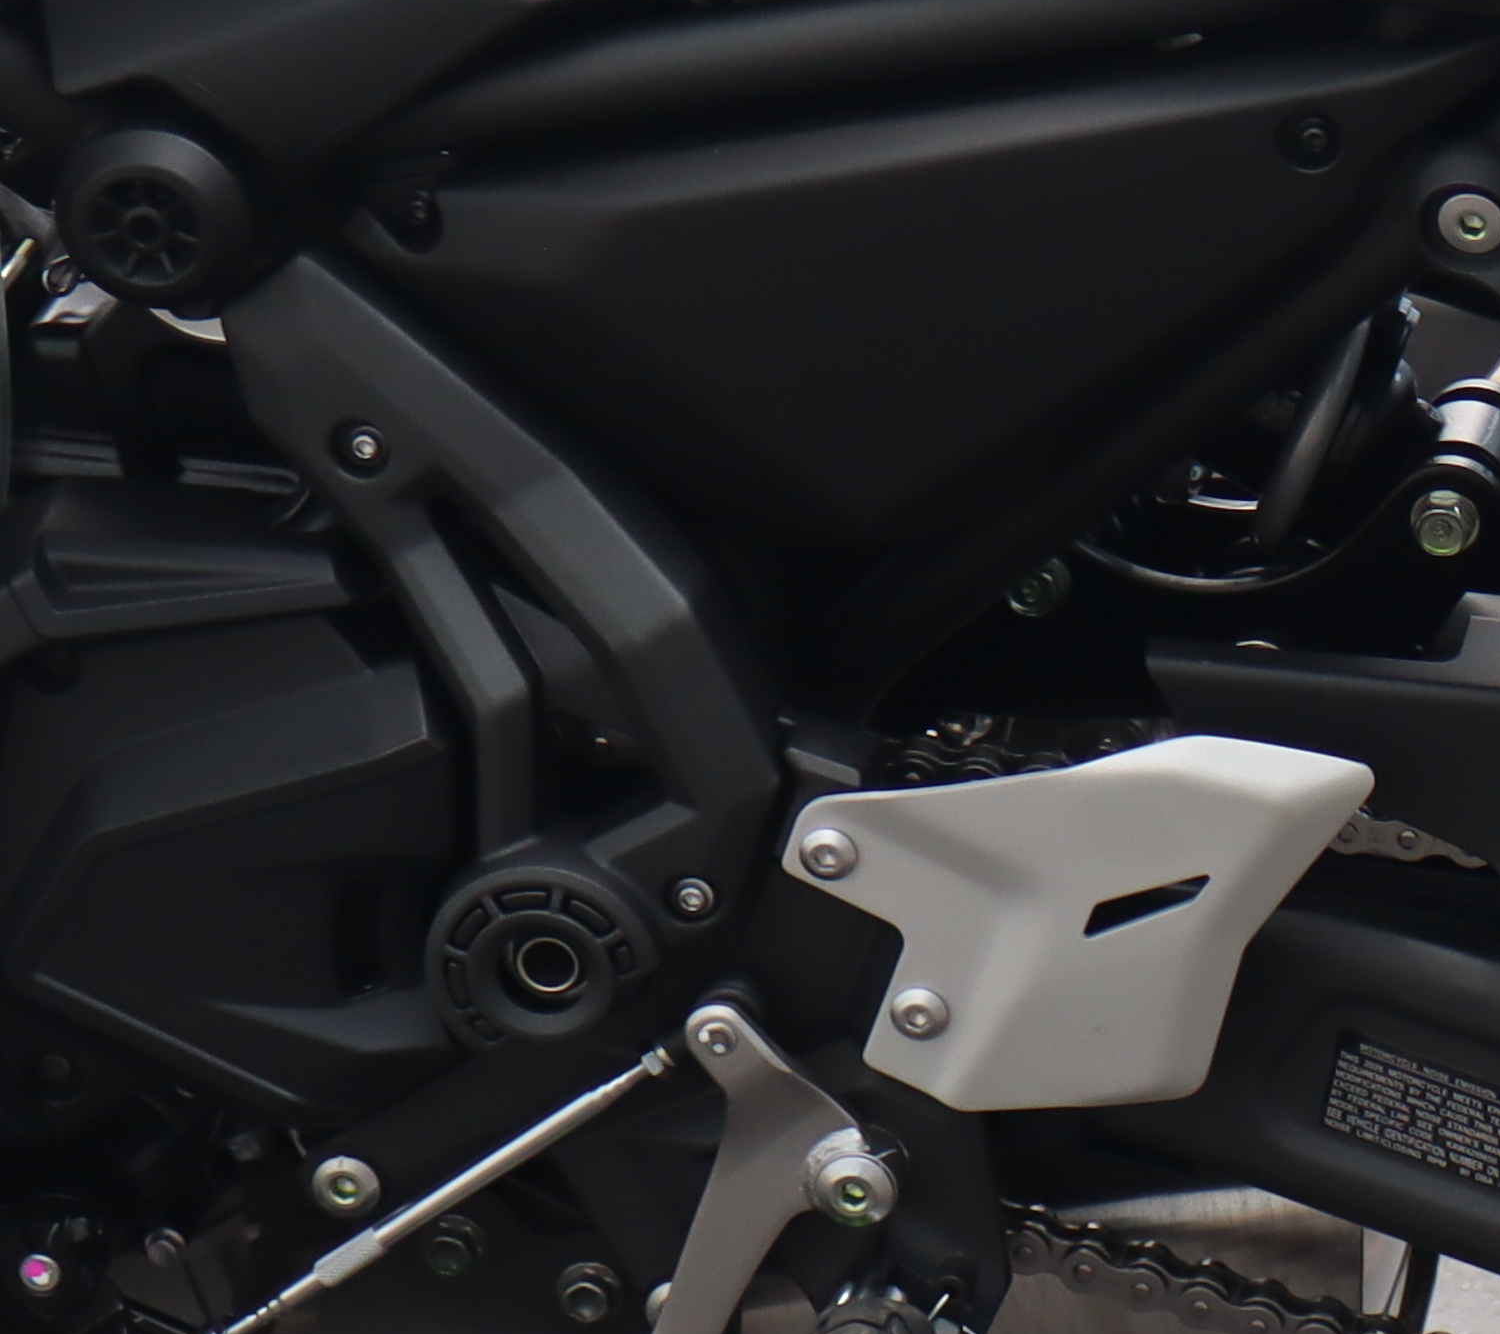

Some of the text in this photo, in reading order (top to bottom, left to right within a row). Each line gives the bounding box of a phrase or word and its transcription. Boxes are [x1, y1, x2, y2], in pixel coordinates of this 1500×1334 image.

[1337, 1059, 1404, 1090] REQUIREMENTS
[1425, 1092, 1440, 1103] THE
[1446, 1100, 1484, 1120] FEDERAL
[1340, 1050, 1358, 1063] THIS
[1387, 1068, 1447, 1096] MOTORCYCLE
[1452, 1092, 1482, 1108] MEETS
[1359, 1043, 1417, 1070] MOTORCYCLE
[1422, 1066, 1448, 1081] NOISE
[1454, 1078, 1496, 1099] EMISSION
[1328, 1097, 1358, 1114] MODEL
[1363, 1110, 1403, 1131] SPECIFIC
[1333, 1079, 1368, 1097] EXCEED
[1372, 1093, 1410, 1112] FEDERAL
[1414, 1108, 1441, 1124] NOISE
[1447, 1120, 1498, 1145] STANDARDS
[1335, 1069, 1401, 1098] MODIFICATIONS
[1406, 1095, 1435, 1111] WHICH
[1439, 1107, 1467, 1123] CAUSE
[1473, 1119, 1492, 1132] THIS
[1346, 1093, 1386, 1114] FEDERAL
[1415, 1119, 1432, 1131] SEE
[1323, 1116, 1350, 1132] NOISE
[1426, 1154, 1447, 1168] RPM
[1326, 1105, 1342, 1119] SEE
[1346, 1113, 1379, 1134] VEHICLE
[1383, 1127, 1446, 1157] IDENTIFICATION
[1449, 1151, 1482, 1171] NUMBER
